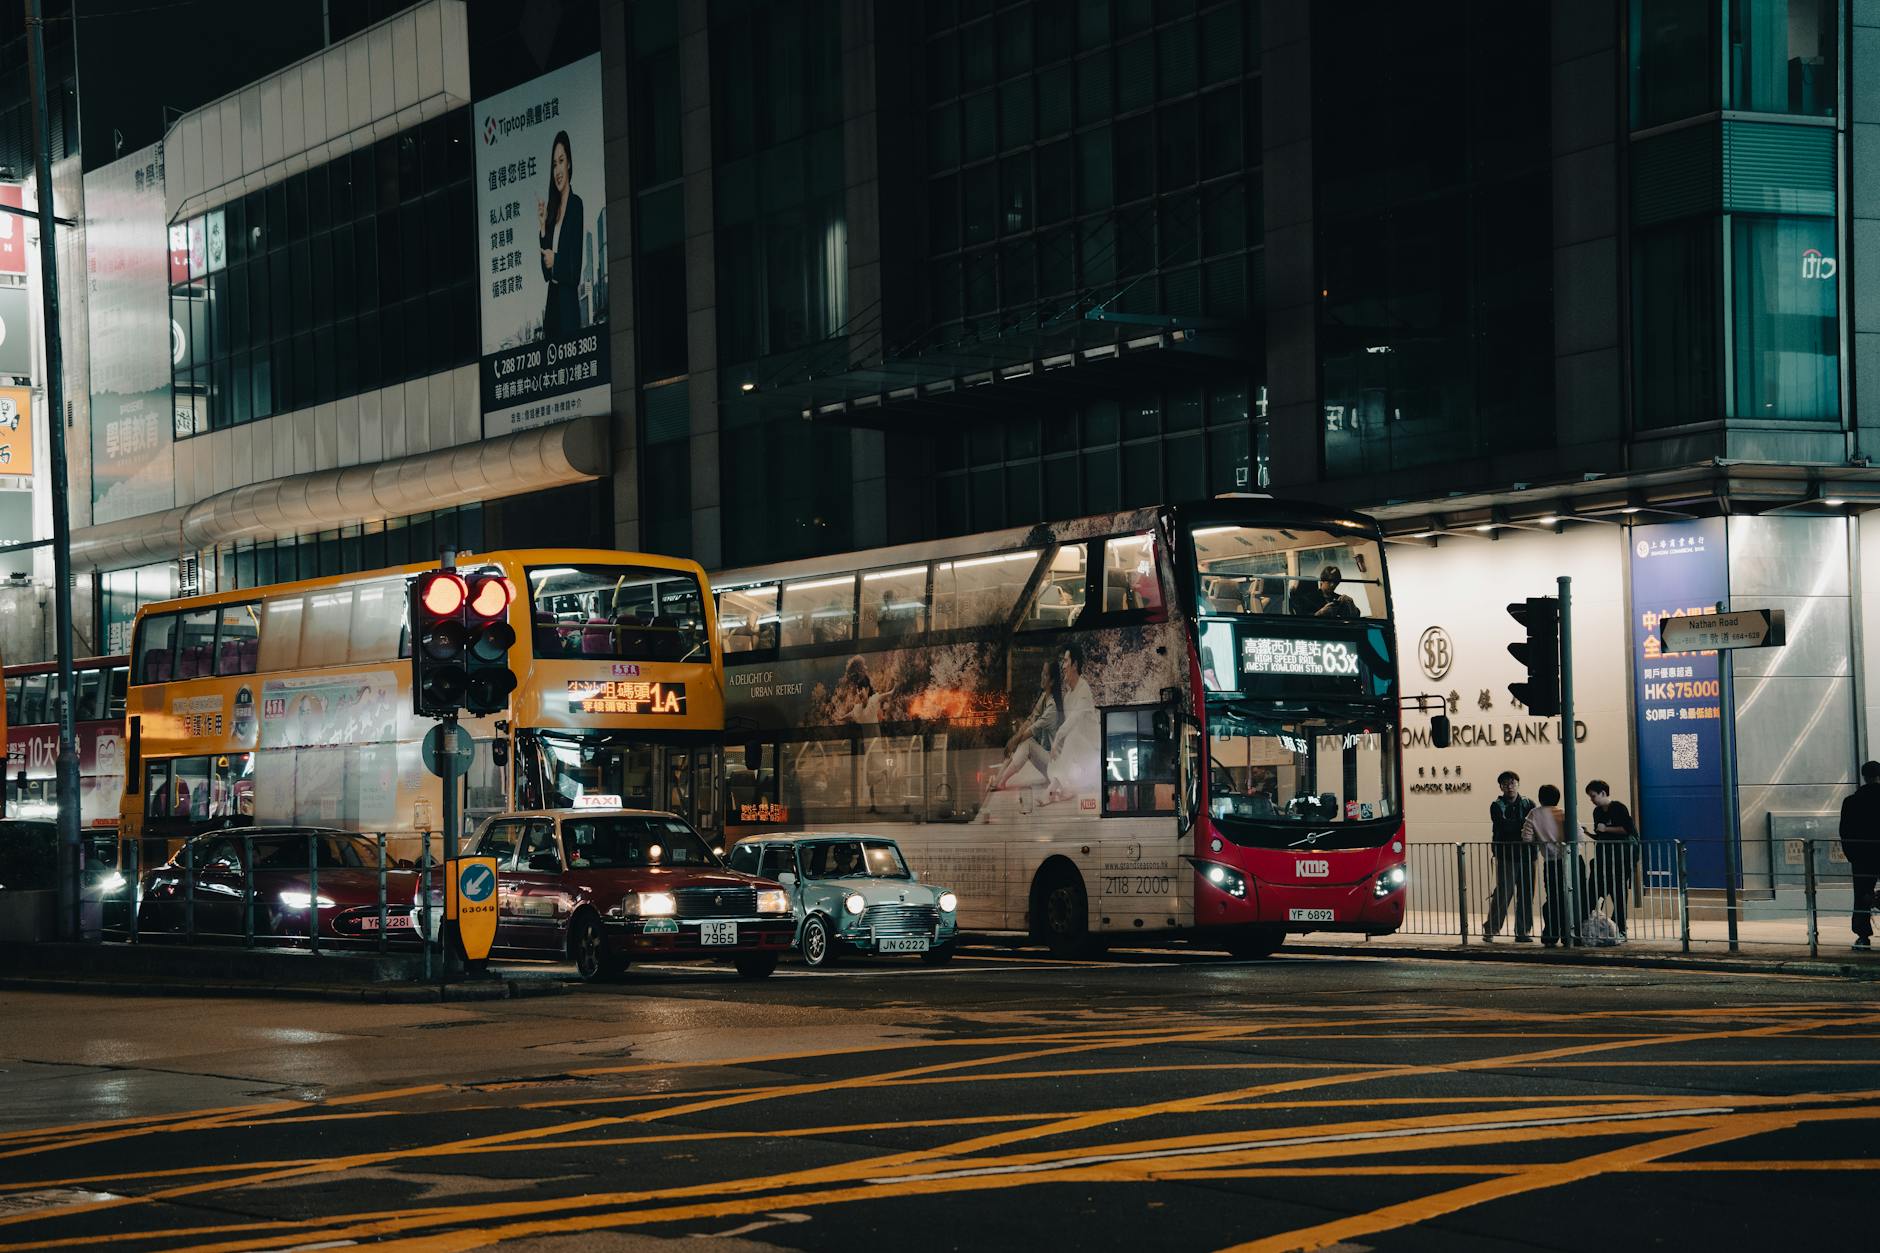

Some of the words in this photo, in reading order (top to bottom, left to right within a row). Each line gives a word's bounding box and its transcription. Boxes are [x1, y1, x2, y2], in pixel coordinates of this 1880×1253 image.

[488, 157, 537, 191] 值得您信任
[490, 201, 520, 225] 私人貸款
[492, 250, 522, 274] 業主貸款
[502, 358, 515, 375] 288
[517, 354, 525, 371] 77
[527, 351, 541, 368] 200
[578, 335, 597, 355] 3803
[1689, 618, 1716, 629] Nathan
[1719, 617, 1739, 627] Road
[1245, 638, 1321, 656] 高鐵西九龍站
[1254, 654, 1272, 663] HIGH
[1275, 656, 1297, 664] SPEED
[1299, 656, 1316, 665] RAIL
[1271, 663, 1304, 672] KOWLOON
[729, 675, 734, 686] A
[735, 672, 762, 686] DELIGHT
[763, 671, 773, 682] OF
[751, 686, 772, 698] URBAN
[775, 682, 803, 696] RETREAT
[651, 683, 680, 713] 1A
[1503, 721, 1550, 744] BANK
[1557, 720, 1588, 743] LD
[582, 797, 617, 806] TAXI
[1296, 860, 1330, 877] KMB
[1105, 876, 1129, 894] 2118
[1136, 876, 1169, 894] 2000
[462, 906, 494, 914] 63049
[1291, 910, 1303, 920] YF
[1307, 910, 1332, 920] 6892
[386, 917, 409, 928] 2281
[711, 923, 726, 933] VP
[704, 933, 735, 944] 7965
[883, 940, 897, 950] JN
[899, 940, 925, 950] 6222
